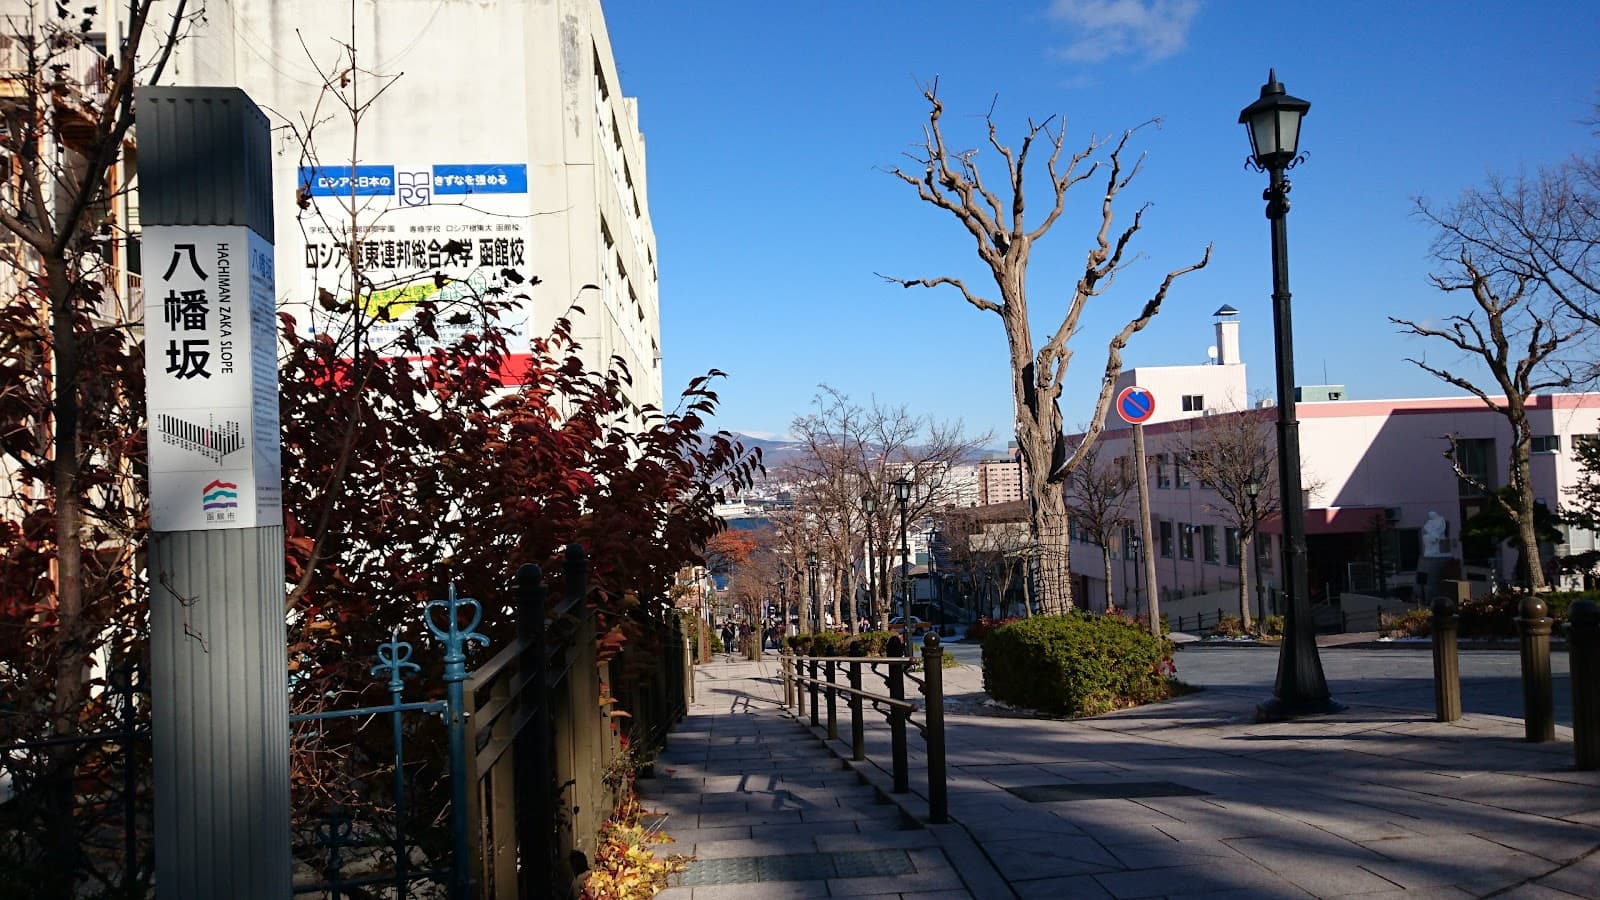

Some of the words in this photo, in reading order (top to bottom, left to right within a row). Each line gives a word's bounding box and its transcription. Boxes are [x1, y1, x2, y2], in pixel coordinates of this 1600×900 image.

[318, 176, 391, 188] ロシアと日本の
[434, 173, 508, 187] きずなを強める
[479, 236, 525, 268] 函館校
[216, 243, 231, 305] HACHIMAN
[162, 243, 213, 381] 八幡坂
[218, 306, 232, 338] ZAKA
[220, 338, 233, 374] SLOPE
